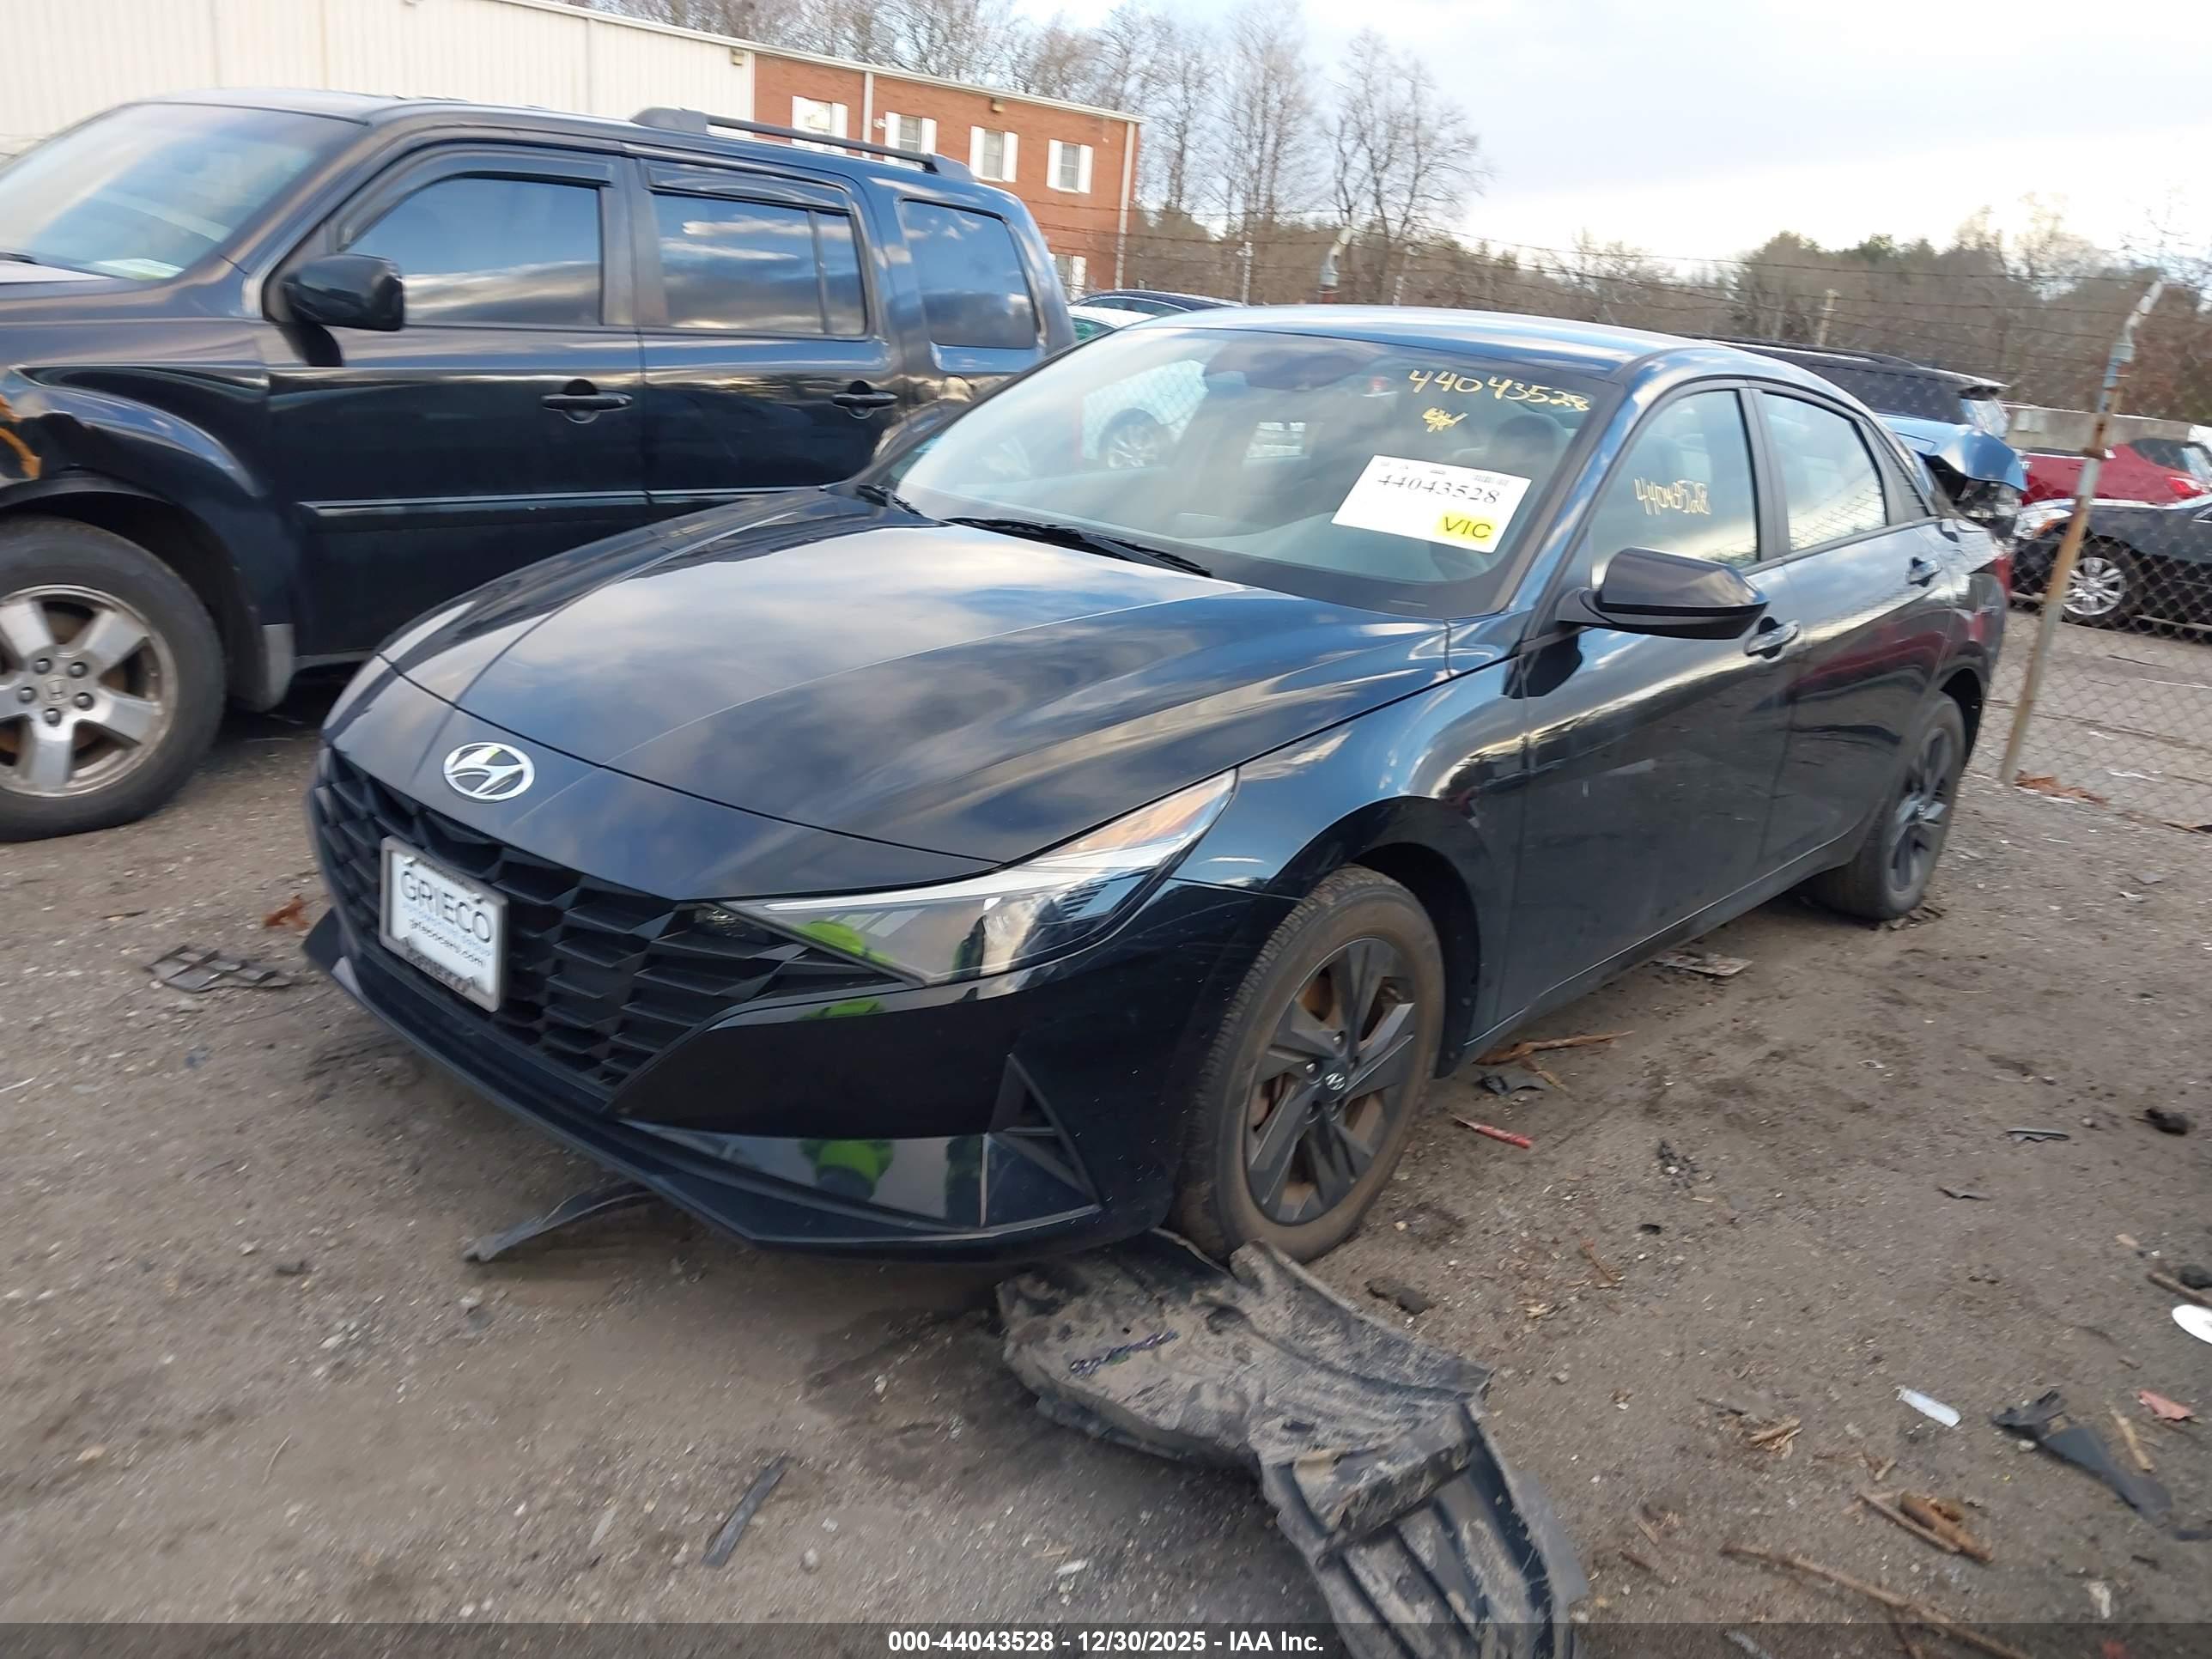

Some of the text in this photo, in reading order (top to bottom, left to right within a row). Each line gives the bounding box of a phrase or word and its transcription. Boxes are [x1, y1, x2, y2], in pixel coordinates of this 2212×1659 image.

[1409, 369, 1590, 412] 44043528
[1377, 473, 1500, 505] 44043528
[1444, 516, 1492, 539] VIC
[400, 870, 492, 944] GRIECO
